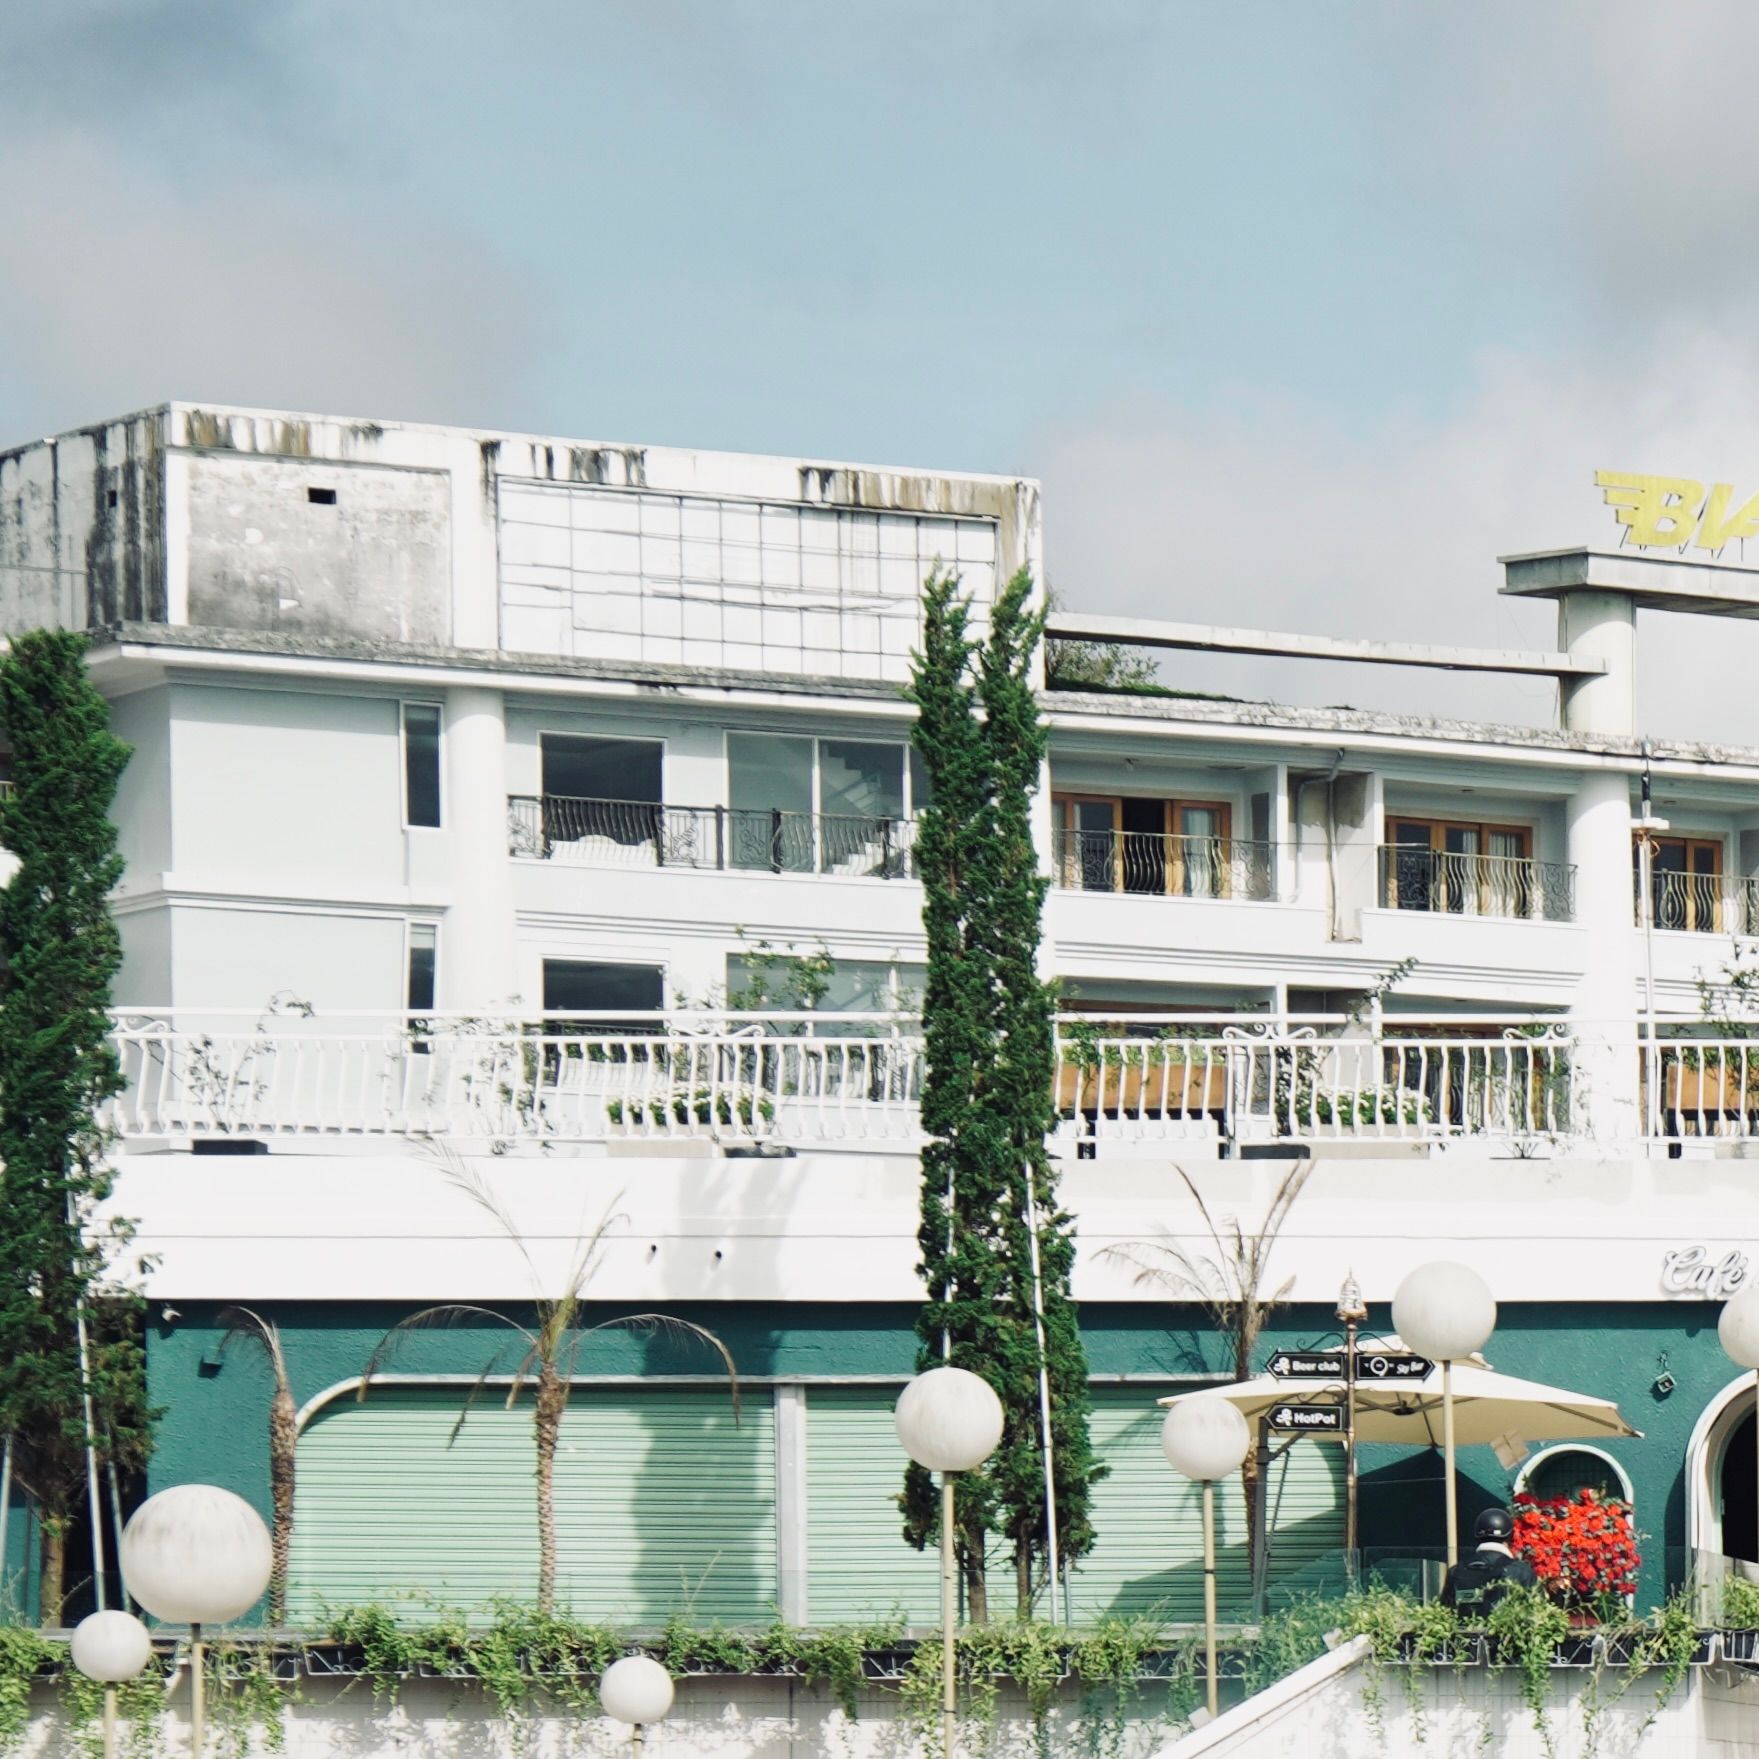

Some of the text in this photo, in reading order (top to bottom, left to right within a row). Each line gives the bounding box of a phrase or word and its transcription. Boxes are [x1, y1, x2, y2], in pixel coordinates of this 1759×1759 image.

[1292, 1360, 1341, 1372] Beer club
[1293, 1412, 1336, 1425] HotPot
